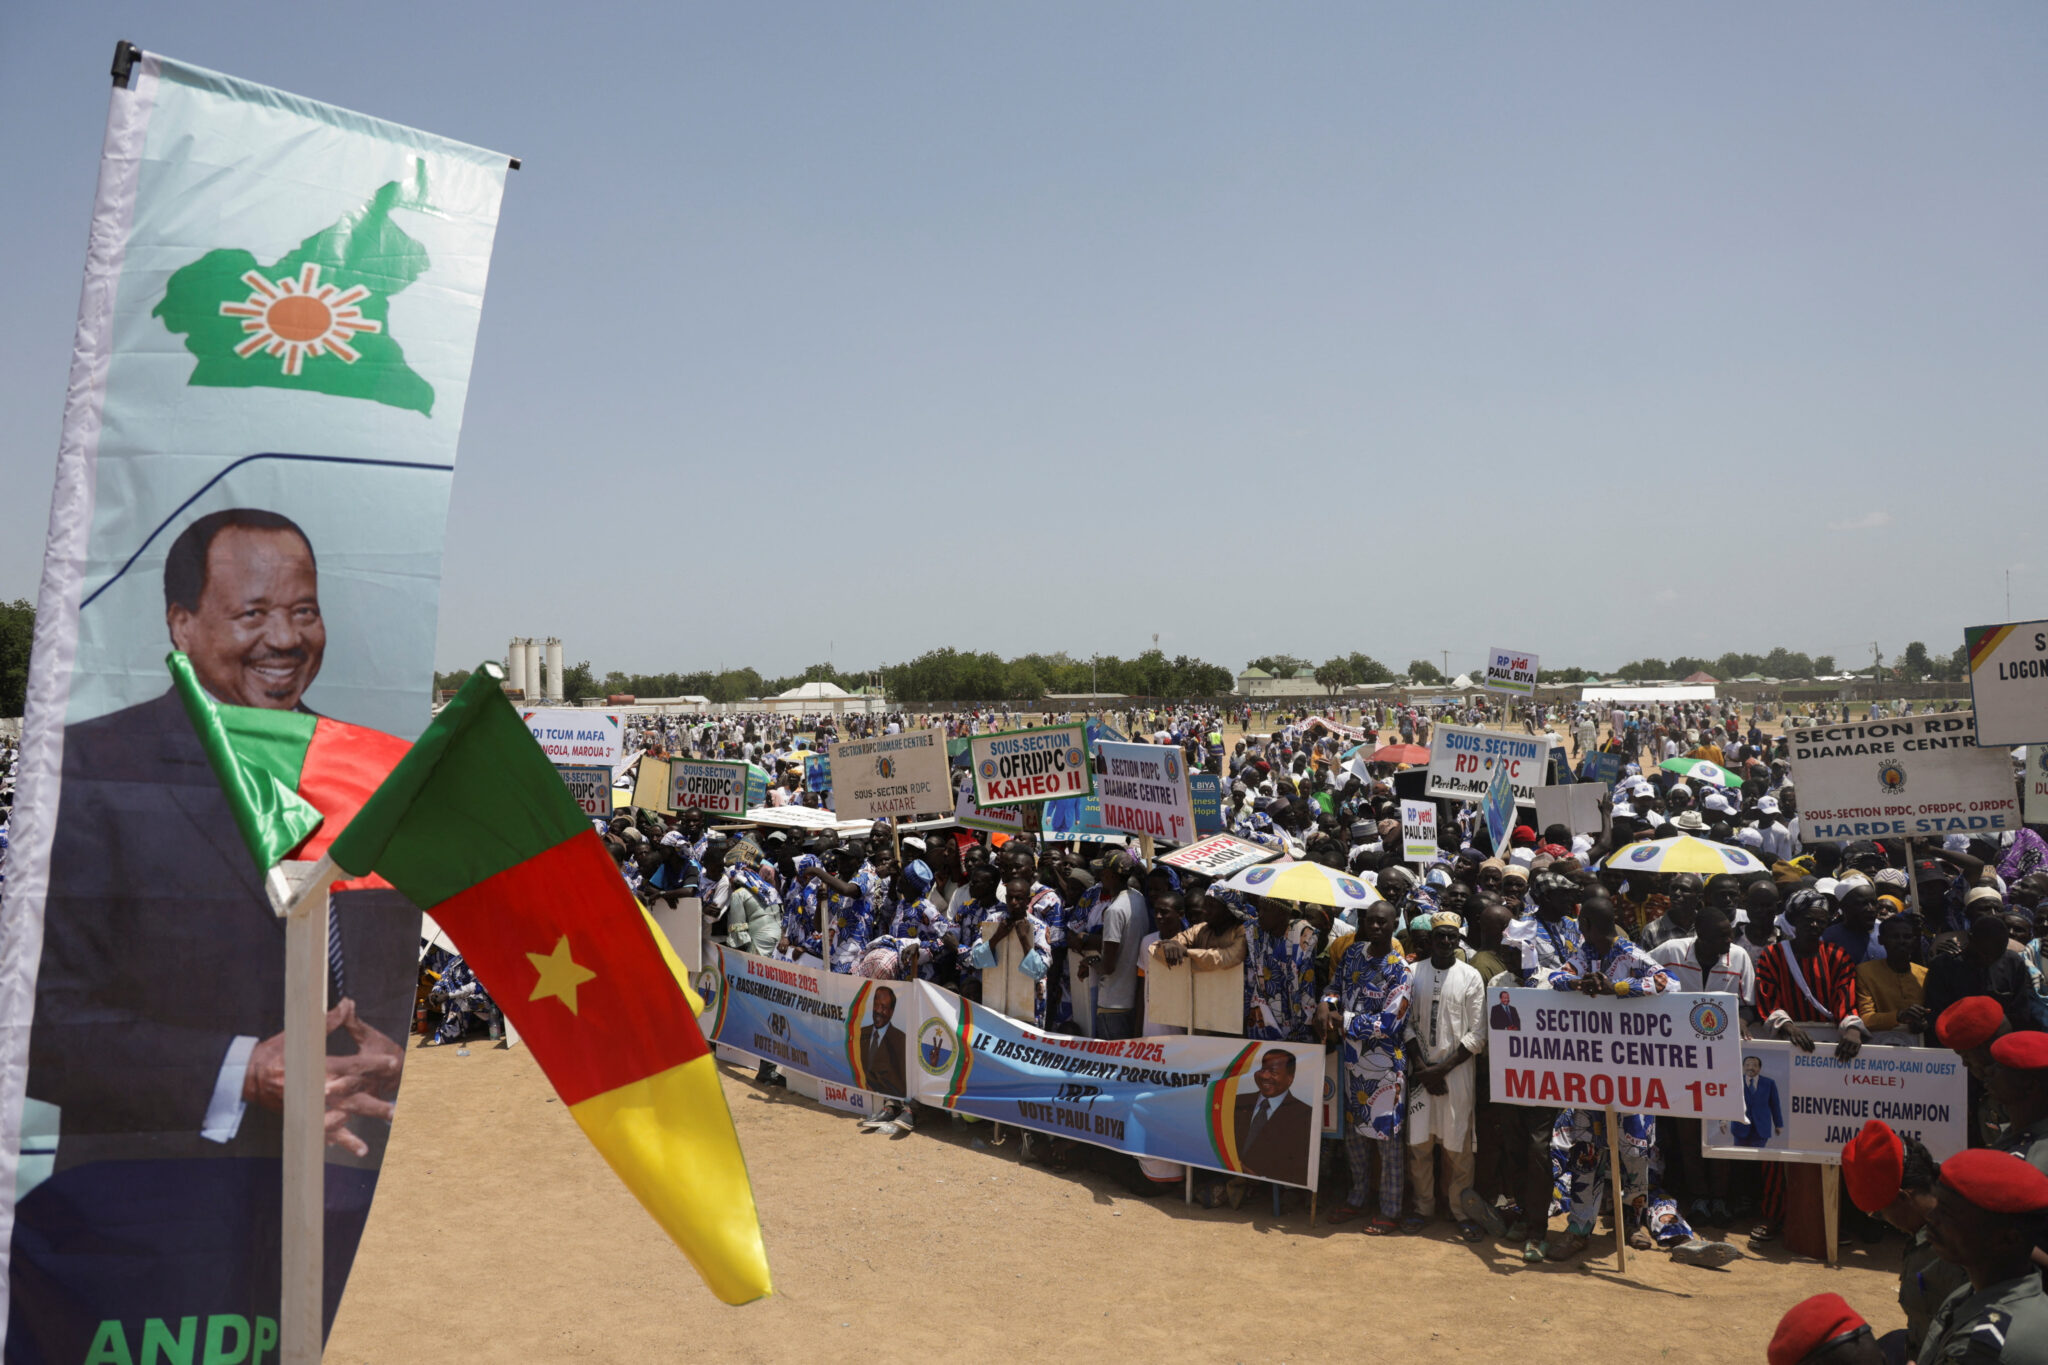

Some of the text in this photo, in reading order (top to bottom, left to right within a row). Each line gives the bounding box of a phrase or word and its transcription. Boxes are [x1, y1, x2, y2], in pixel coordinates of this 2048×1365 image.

[2035, 633, 2048, 651] S
[1497, 656, 1528, 670] RP yidi
[1488, 667, 1534, 683] PAUL BIYA
[547, 729, 574, 740] TCUM
[576, 730, 605, 741] MAFA
[1796, 722, 1913, 743] SECTION
[541, 745, 570, 757] NGOLA,
[572, 746, 603, 757] MAROUA
[839, 745, 862, 758] SECTION
[862, 742, 876, 754] RDPC
[877, 740, 902, 752] DIAMARE
[904, 736, 928, 748] CENTRE
[990, 733, 1070, 756] SOUS-SECTION
[1798, 736, 1976, 760] DIAMARE CENTR
[684, 765, 736, 778] SOUS-SECTION
[1000, 749, 1065, 779] OFRDPC
[1112, 759, 1160, 781] SECTION RDPC
[1455, 753, 1478, 773] RD
[567, 783, 594, 798] RDPC
[688, 777, 731, 796] OFRDPC
[855, 782, 931, 799] SOUS-SECTION RDPC
[988, 774, 1060, 800] KAHEO
[1067, 771, 1081, 790] II
[1104, 779, 1178, 806] DIAMARE CENTRE I
[677, 793, 739, 811] KAHEO I
[870, 797, 916, 813] KAKATARE
[1194, 808, 1216, 816] Hope
[1805, 800, 2015, 820] SOUS-SECTION RPDC, OFRDPC, OJRDPC
[1104, 804, 1184, 838] MAROUA 1er
[1408, 808, 1432, 826] RP yetti
[1815, 814, 2006, 838] HARDE STADE
[1404, 825, 1436, 840] PAUL BIYA
[748, 960, 819, 995] LE 12 OCTOBRE 2025,
[736, 977, 799, 1009] RASSEMBLEMENT
[798, 996, 845, 1024] POPULAIRE,
[768, 1012, 791, 1042] (RP)
[1536, 1008, 1672, 1037] SECTION RDPC
[754, 1033, 772, 1053] VOTE
[773, 1039, 790, 1060] PAUL
[791, 1047, 809, 1067] BIYA
[972, 1033, 992, 1051] LE
[993, 1039, 1118, 1080] RASSEMBLEMENT
[1124, 1041, 1166, 1064] 2025,
[1509, 1036, 1713, 1069] DIAMARE CENTRE I
[1795, 1055, 1956, 1075] DELEGATION DE MAYO-KANI OUEST
[1505, 1068, 1728, 1112] MAROUA 1er
[1852, 1074, 1896, 1086] KAELE
[850, 1093, 863, 1108] RP
[1792, 1096, 1949, 1122] BIENVENUE CHAMPION
[1018, 1100, 1124, 1140] VOTE PAUL BIYA
